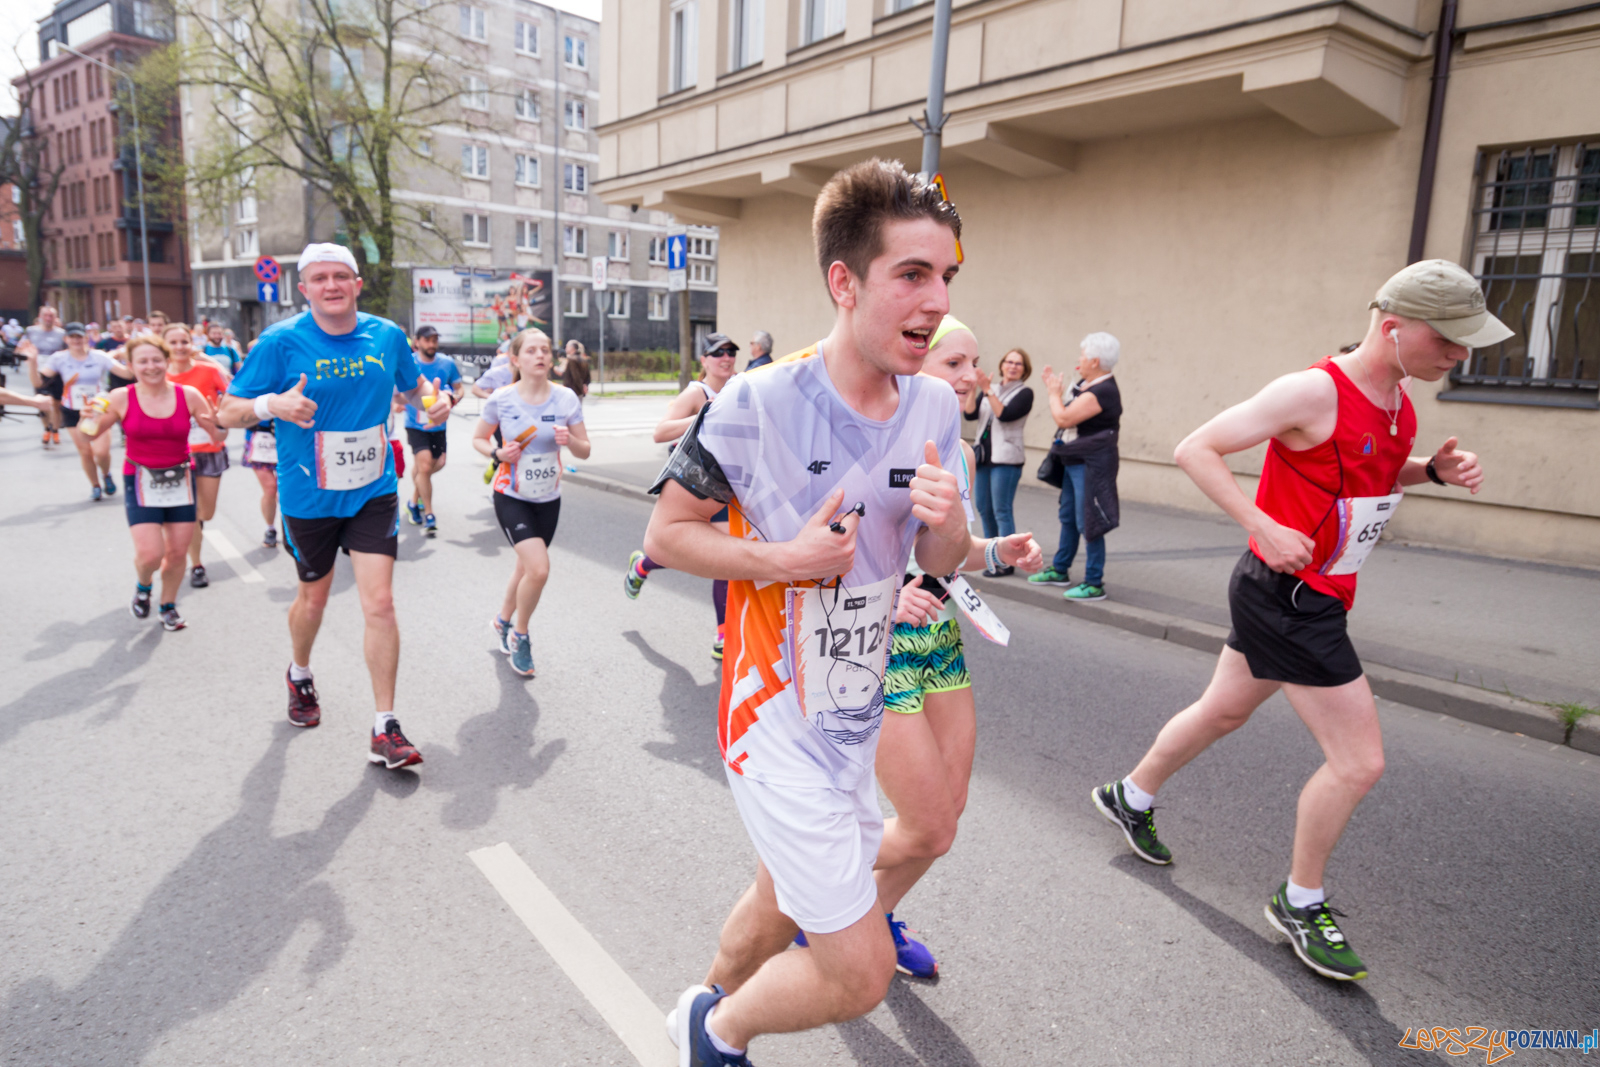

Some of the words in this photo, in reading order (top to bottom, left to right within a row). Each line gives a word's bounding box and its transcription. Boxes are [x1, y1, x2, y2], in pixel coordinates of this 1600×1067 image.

[316, 357, 365, 380] RUN
[335, 447, 376, 466] 3148
[525, 466, 556, 481] 8965
[807, 460, 831, 475] 4F
[814, 614, 887, 657] 12128
